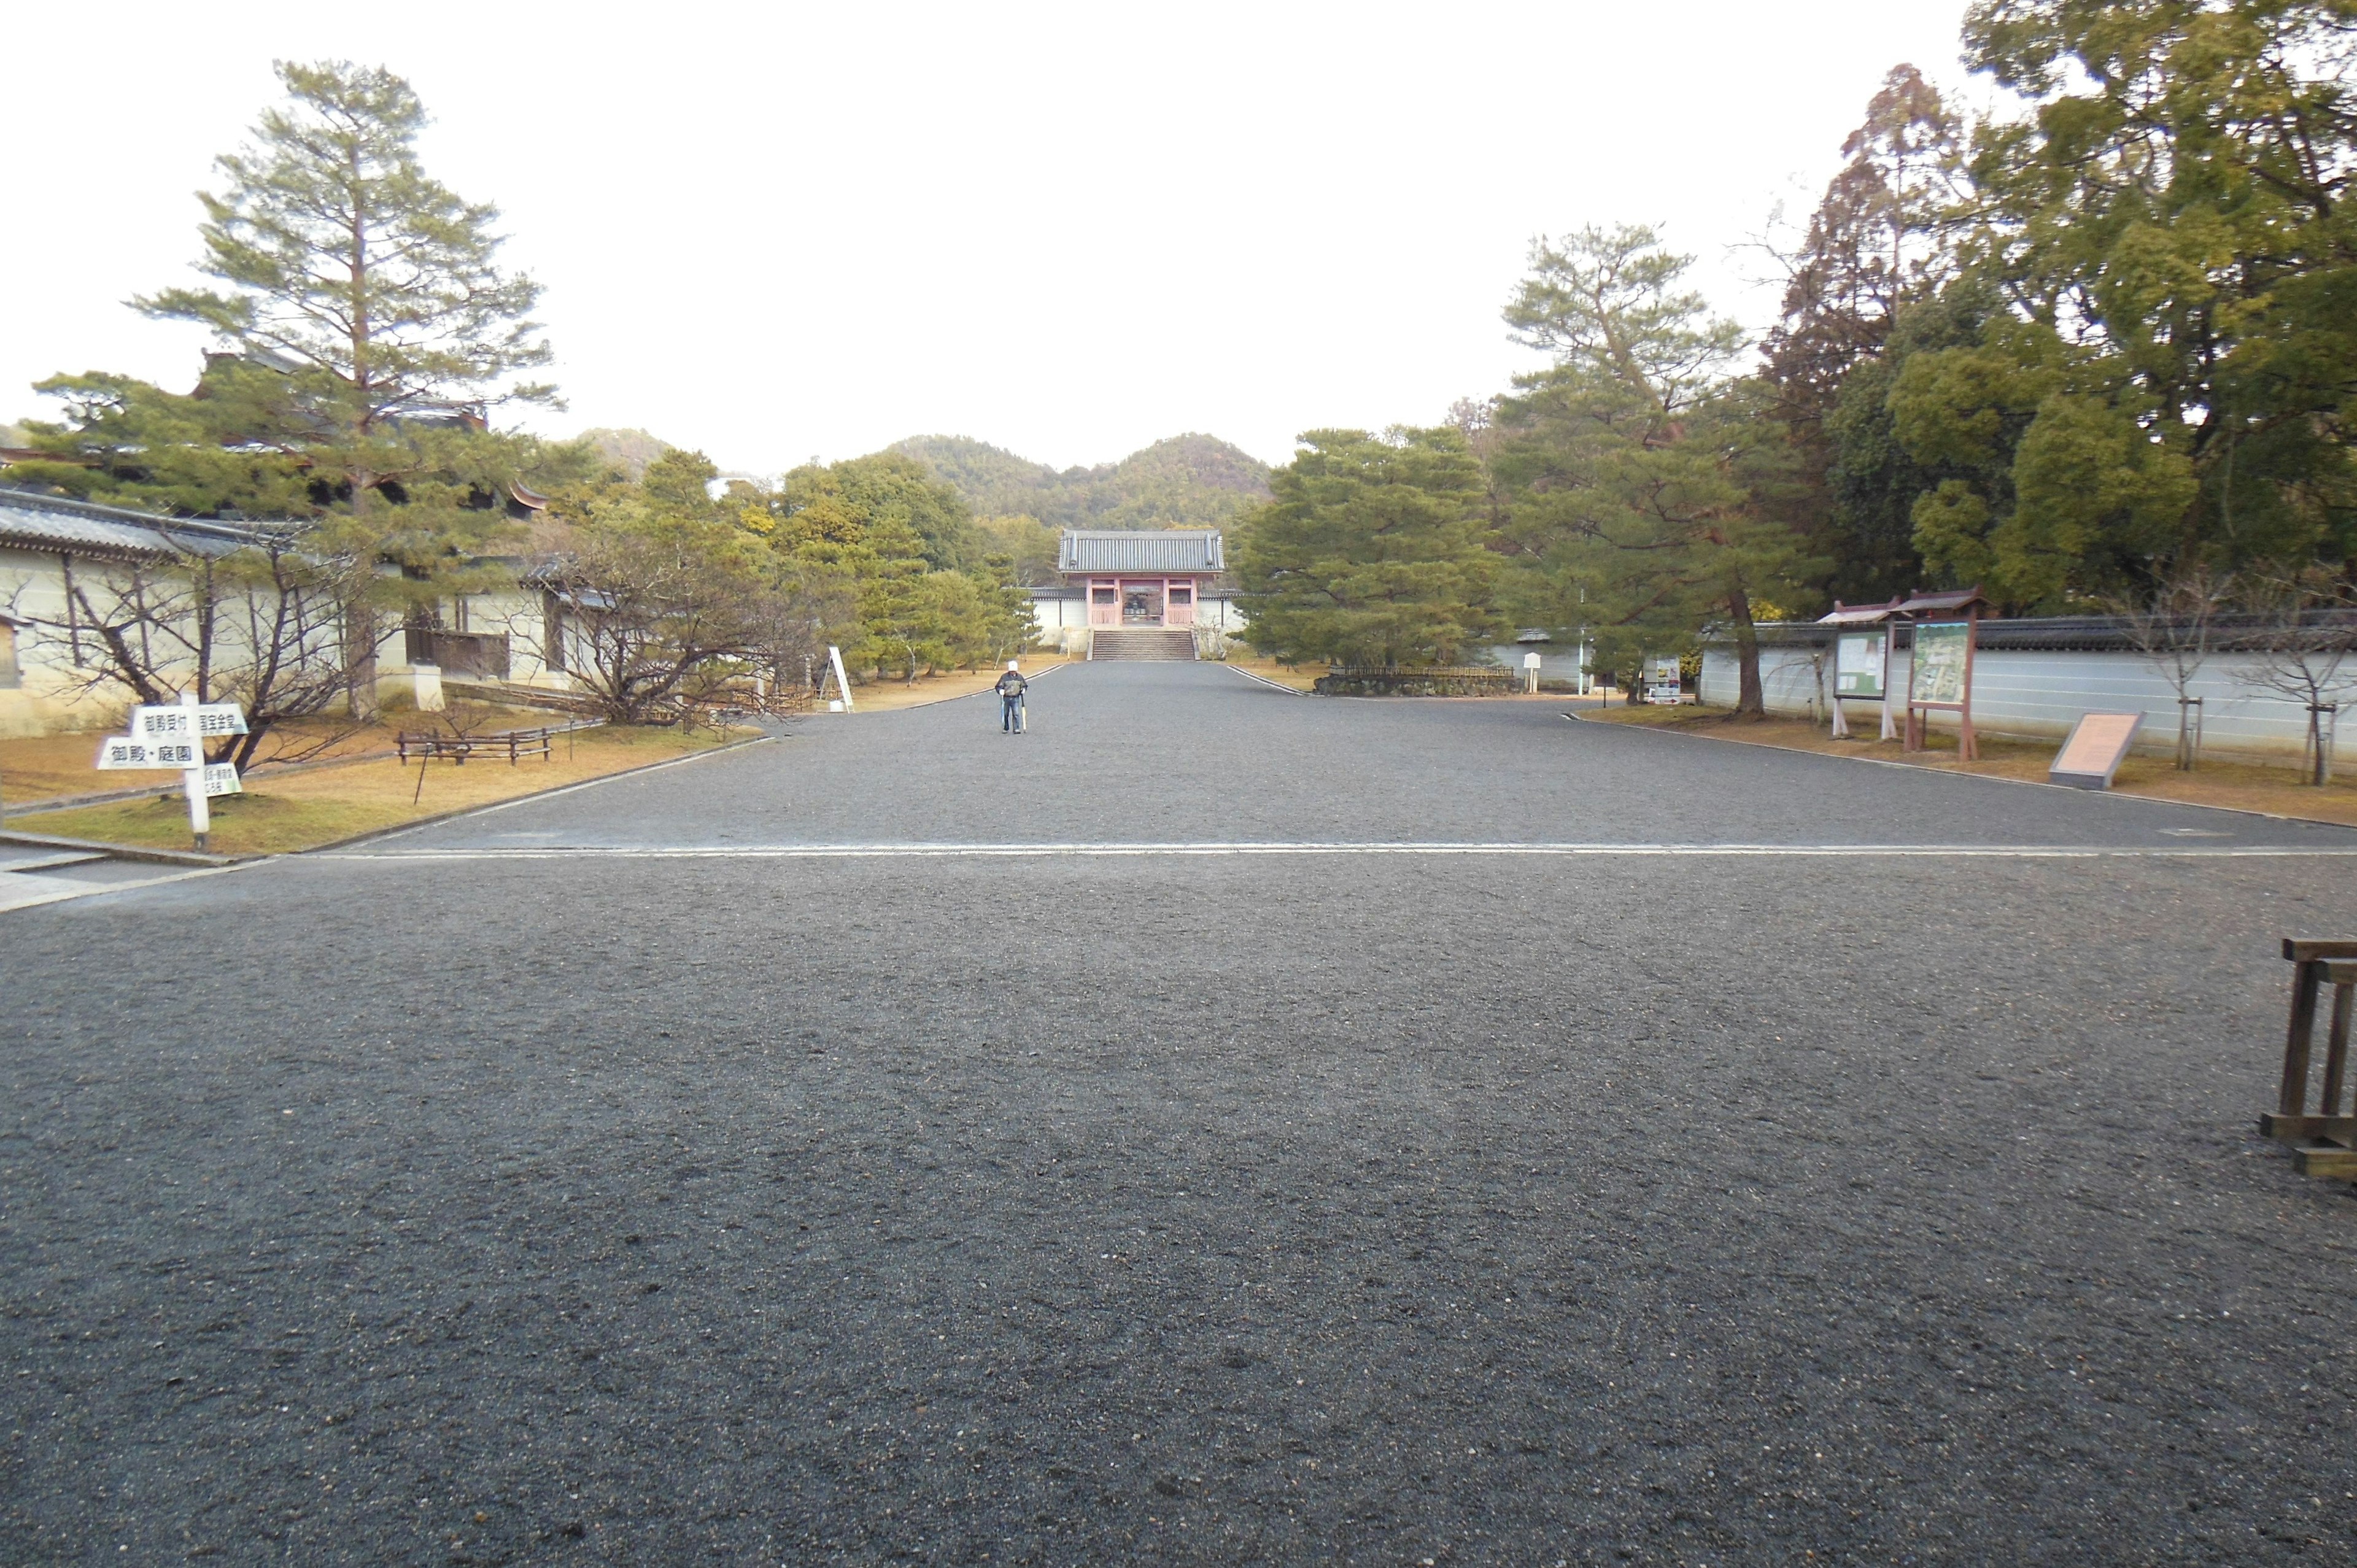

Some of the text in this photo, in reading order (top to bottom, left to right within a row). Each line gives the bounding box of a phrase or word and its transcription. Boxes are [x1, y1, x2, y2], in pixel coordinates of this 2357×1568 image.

[145, 714, 187, 731] 御殿受付
[111, 746, 192, 761] 御殿・庭園
